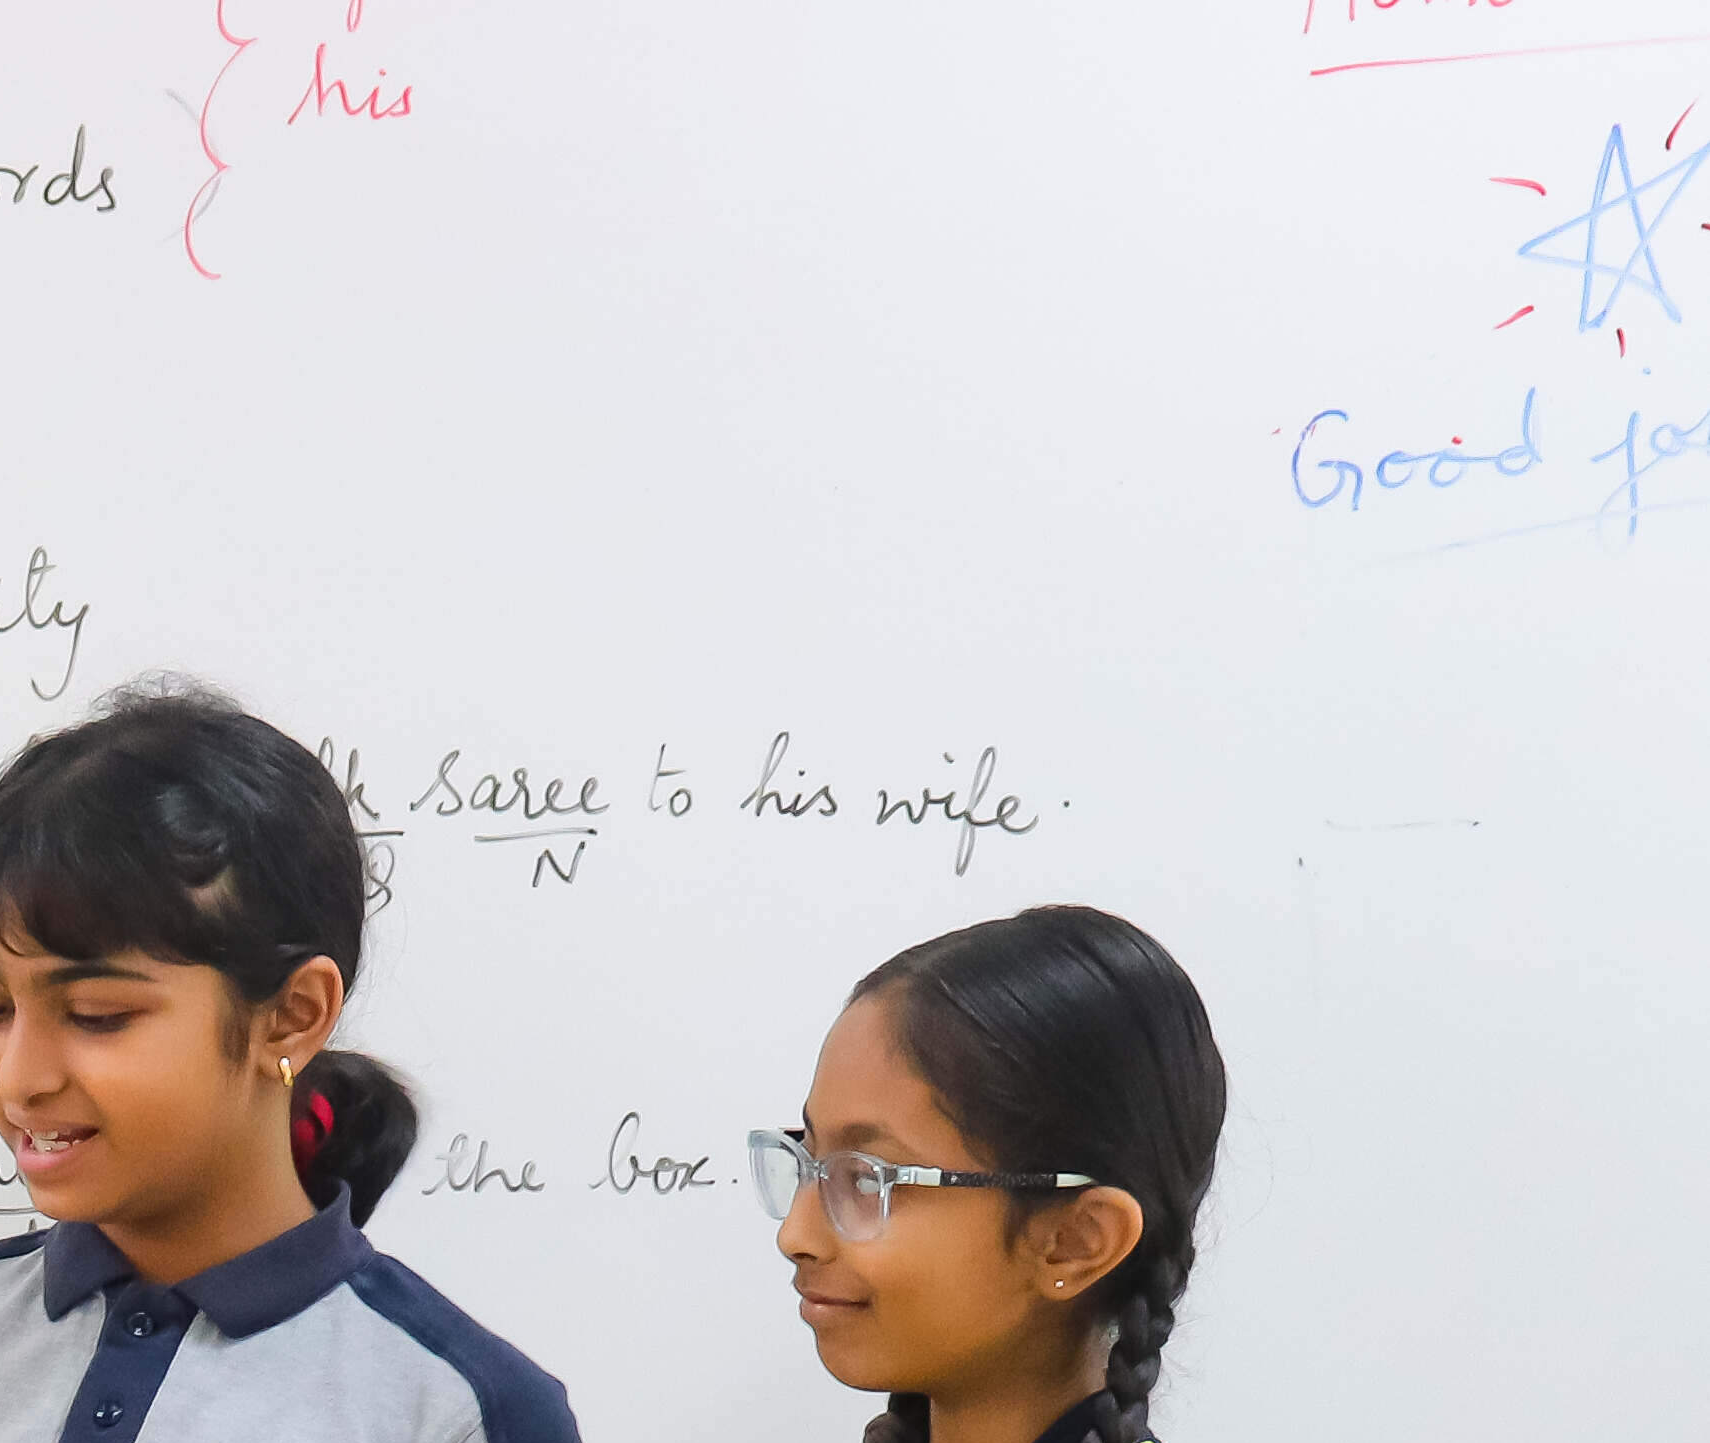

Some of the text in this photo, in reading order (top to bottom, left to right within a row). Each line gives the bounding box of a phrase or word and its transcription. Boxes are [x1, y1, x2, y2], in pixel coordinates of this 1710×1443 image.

[287, 42, 412, 126] his
[1291, 386, 1542, 512] Good
[646, 742, 693, 819] to
[740, 731, 841, 818] his
[531, 840, 586, 888] N
[420, 1132, 546, 1197] the
